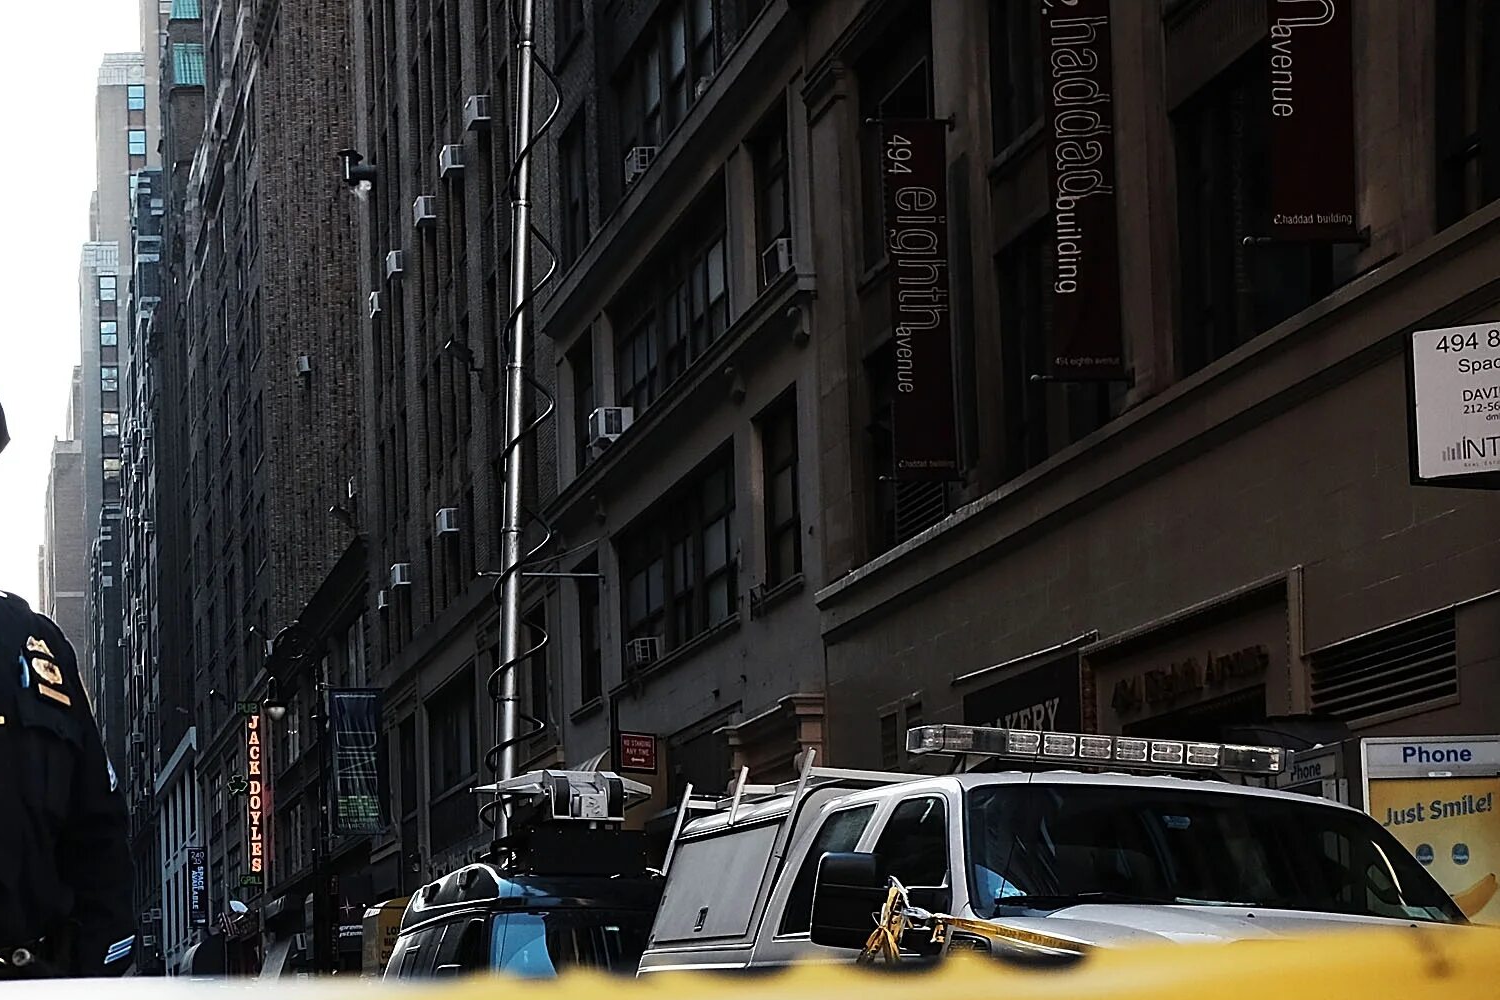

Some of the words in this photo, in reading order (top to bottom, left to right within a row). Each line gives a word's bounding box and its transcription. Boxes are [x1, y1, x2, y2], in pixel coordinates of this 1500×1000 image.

[1270, 24, 1294, 117] avenue
[887, 133, 913, 175] 494
[1317, 213, 1353, 226] building
[890, 186, 948, 331] eighth
[1055, 196, 1083, 295] building
[895, 323, 914, 394] avenue
[1436, 331, 1479, 353] 494
[1463, 386, 1500, 402] DAVI
[237, 703, 258, 714] PUB
[981, 697, 1060, 732] KERY
[248, 715, 261, 775] JACK
[1402, 746, 1473, 763] Phone
[1290, 762, 1322, 783] Phone
[249, 780, 262, 873] DOYLES
[1382, 802, 1425, 827] Just
[1429, 791, 1493, 821] Smile!
[191, 870, 199, 910] AVAILABLE
[197, 866, 205, 891] SPACE
[240, 875, 263, 885] GRILL
